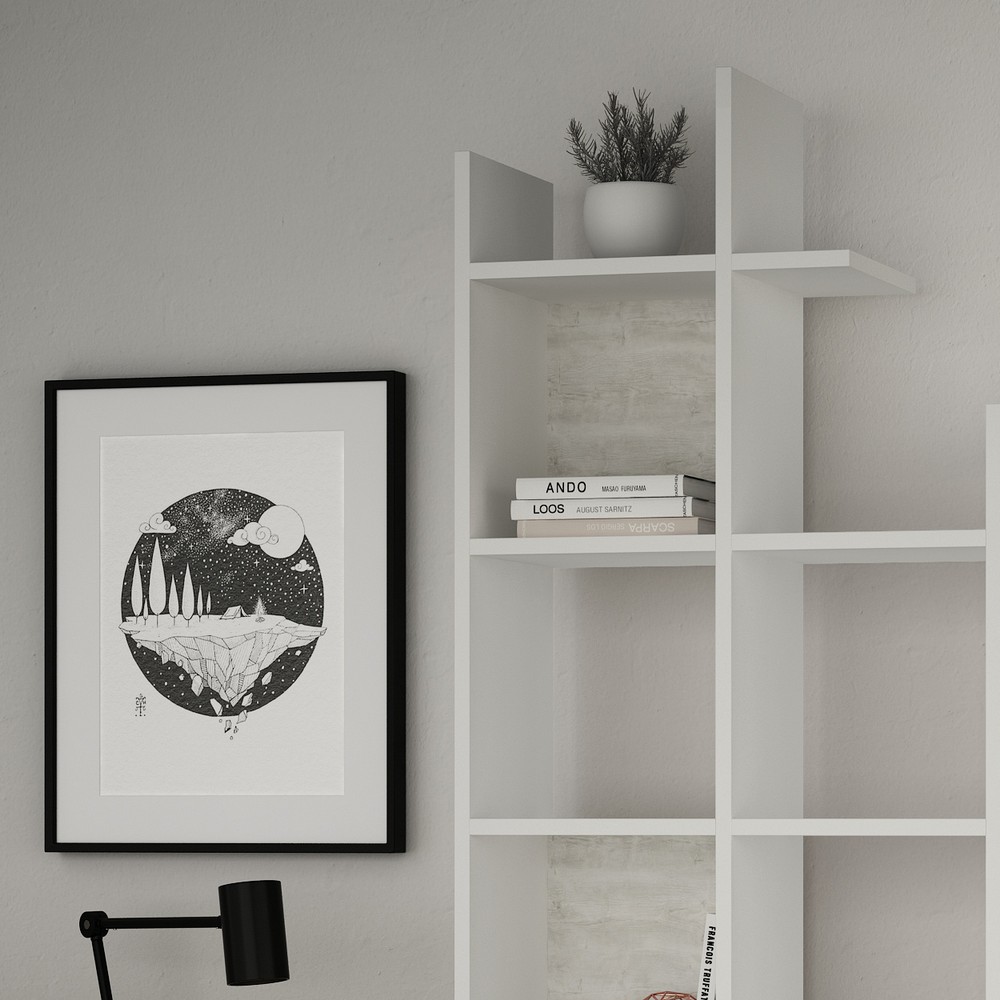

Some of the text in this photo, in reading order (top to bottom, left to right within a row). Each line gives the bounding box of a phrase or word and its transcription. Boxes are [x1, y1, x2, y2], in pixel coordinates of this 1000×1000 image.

[546, 481, 587, 494] ANDO
[533, 504, 632, 515] LOOS AUGUST SARNITZ
[628, 522, 676, 533] SCARPA
[705, 926, 716, 965] FRANCOIS
